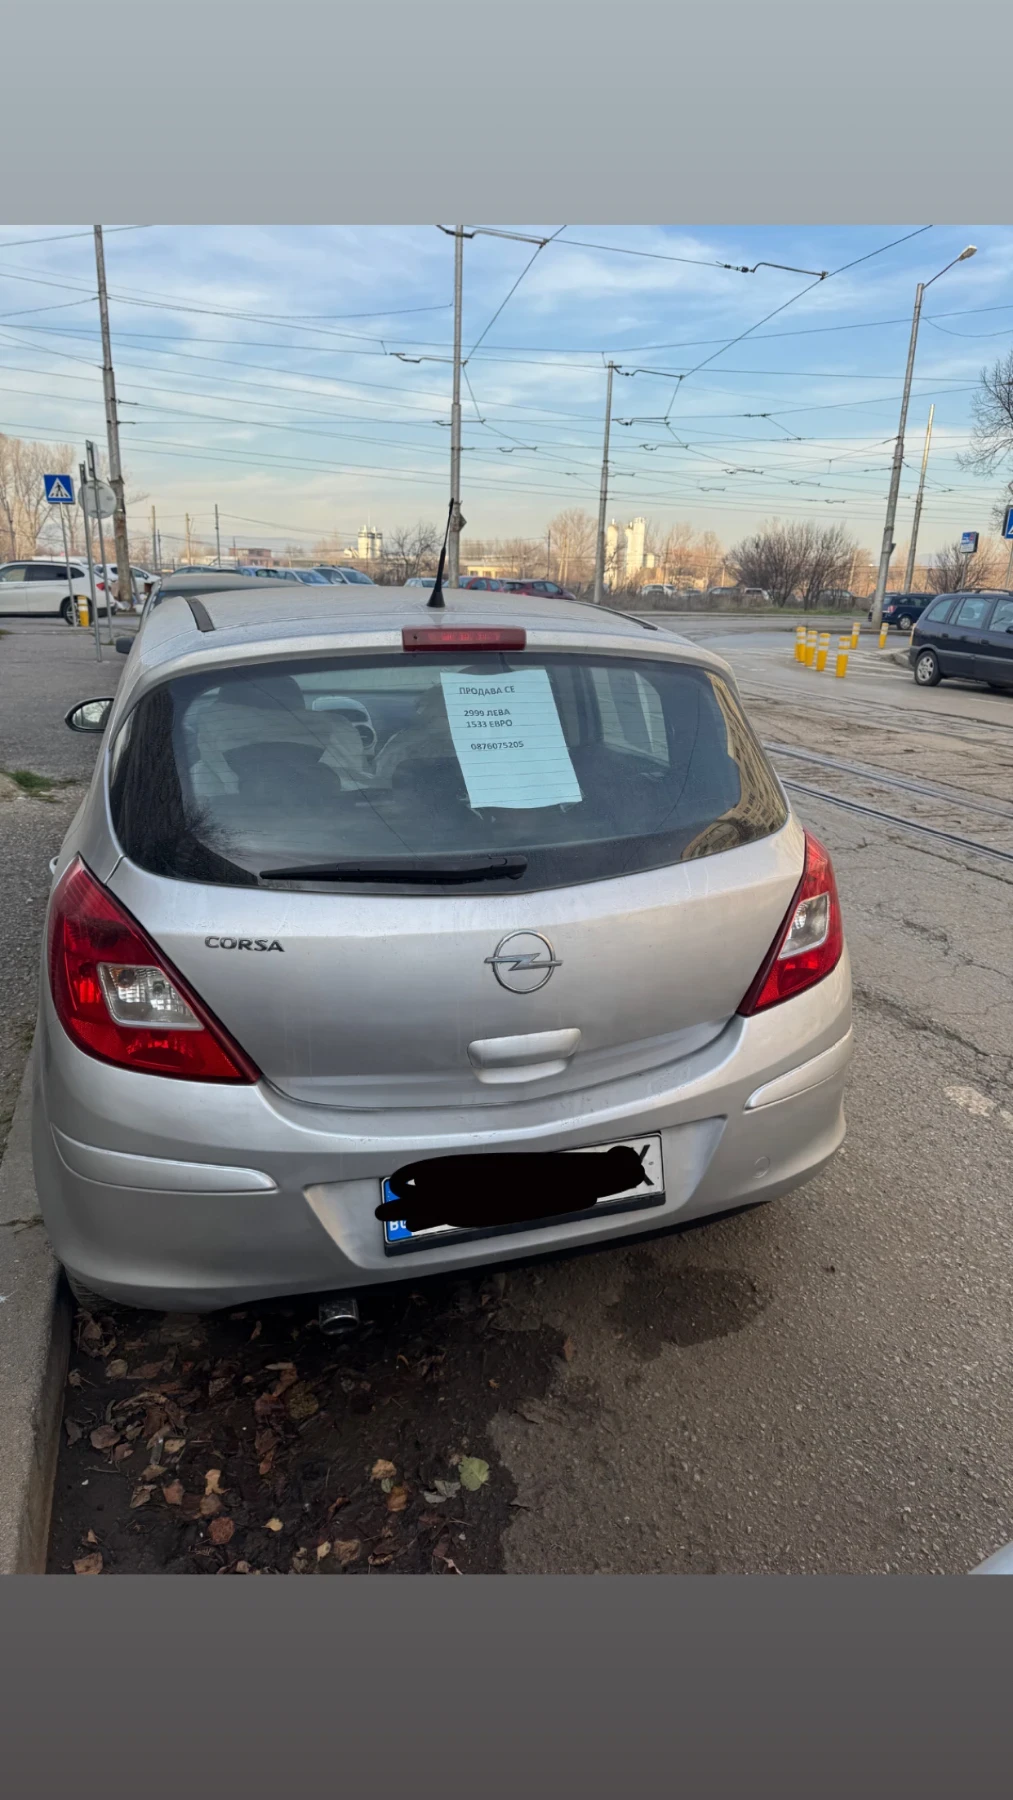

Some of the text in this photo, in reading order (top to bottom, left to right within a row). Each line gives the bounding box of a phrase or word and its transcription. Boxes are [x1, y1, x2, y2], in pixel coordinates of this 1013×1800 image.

[459, 685, 515, 696] ПРОДАВА СЕ
[489, 720, 512, 728] ЕВРО
[470, 740, 524, 750] 0876075205
[204, 935, 285, 953] CORSA
